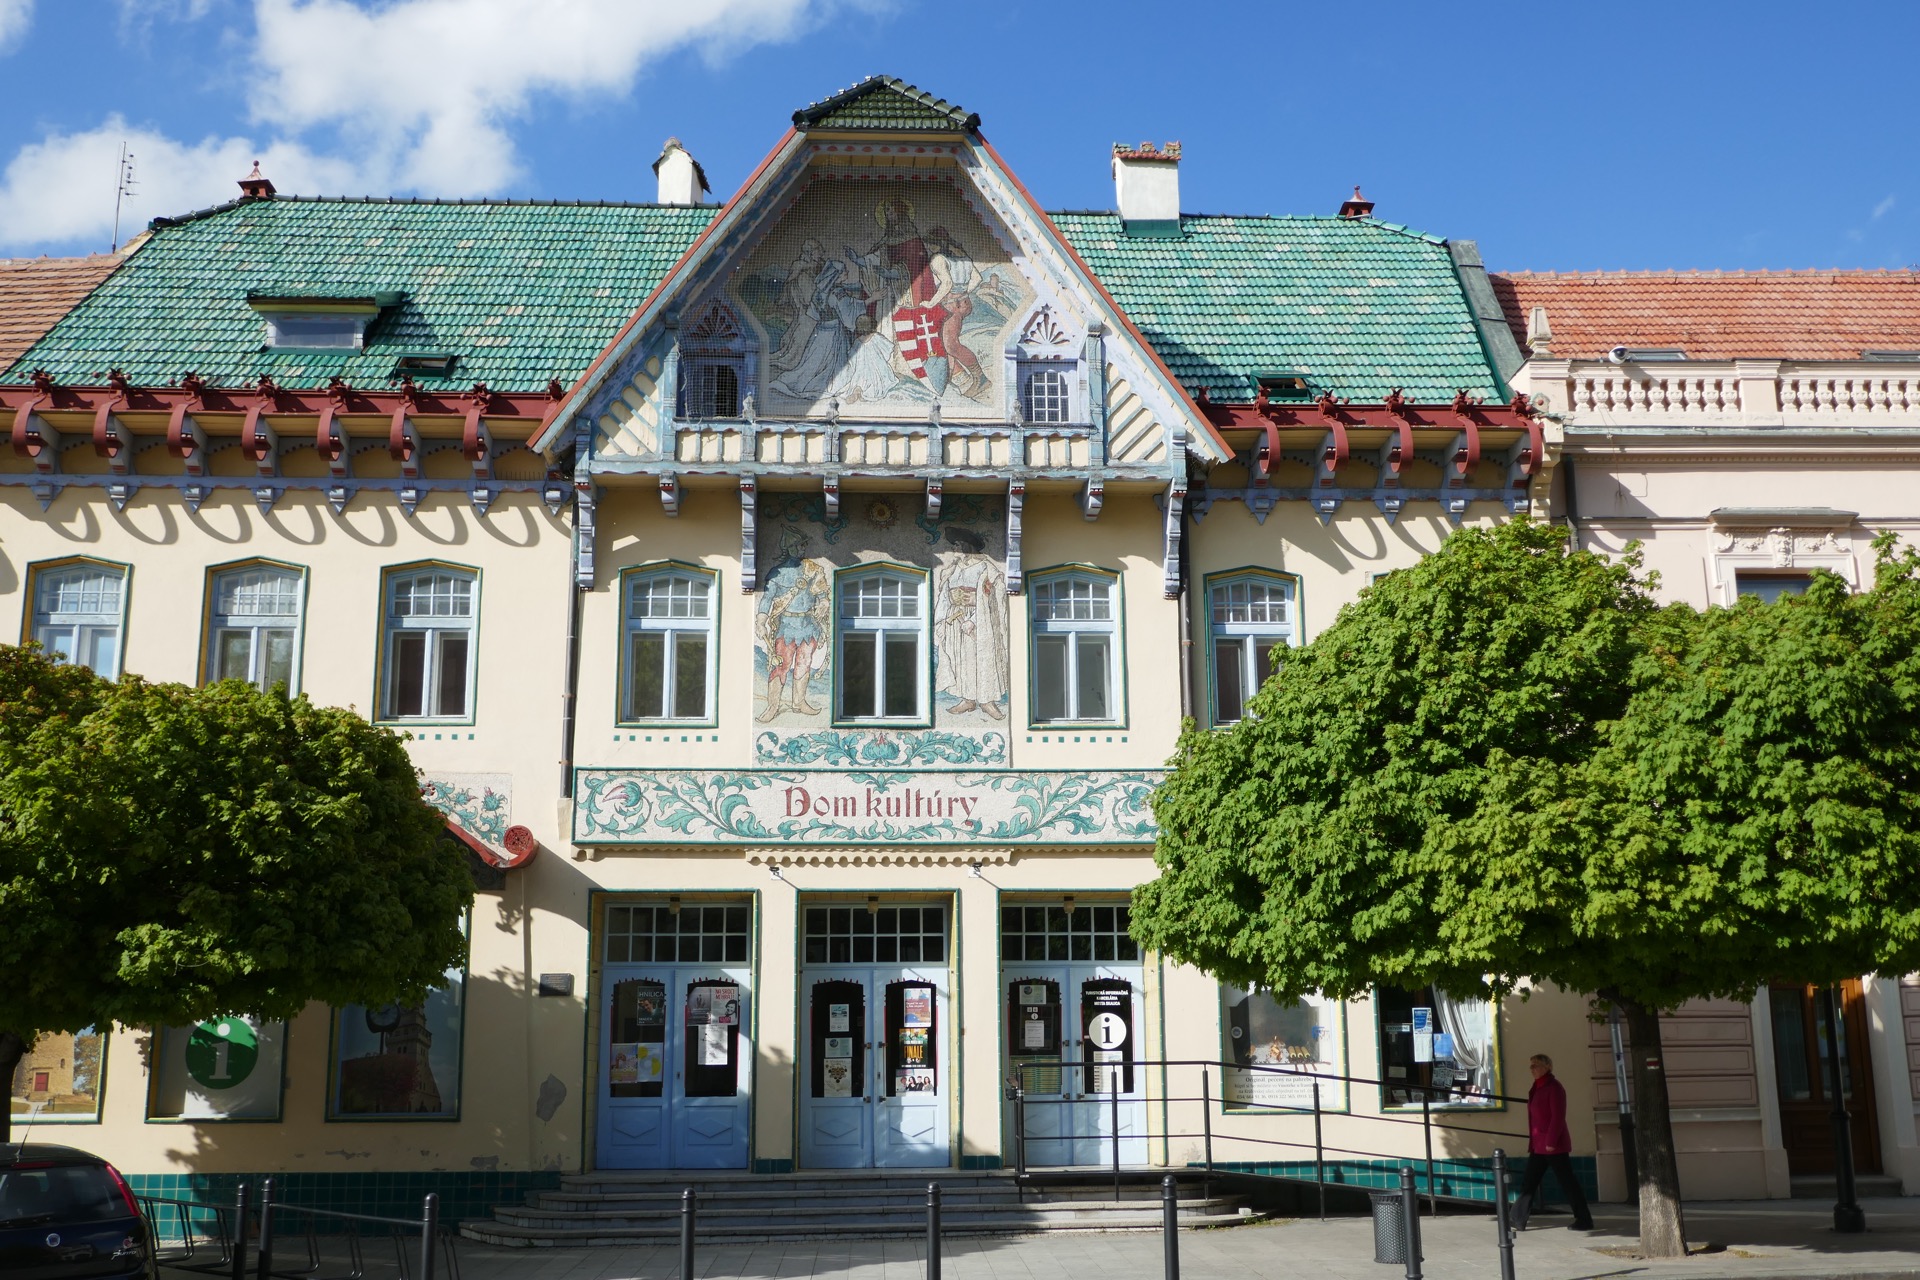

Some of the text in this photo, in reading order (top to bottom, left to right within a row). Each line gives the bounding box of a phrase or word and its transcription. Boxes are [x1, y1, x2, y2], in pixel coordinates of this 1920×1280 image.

[781, 786, 979, 827] Dom kultúry
[903, 1045, 924, 1059] FINALE
